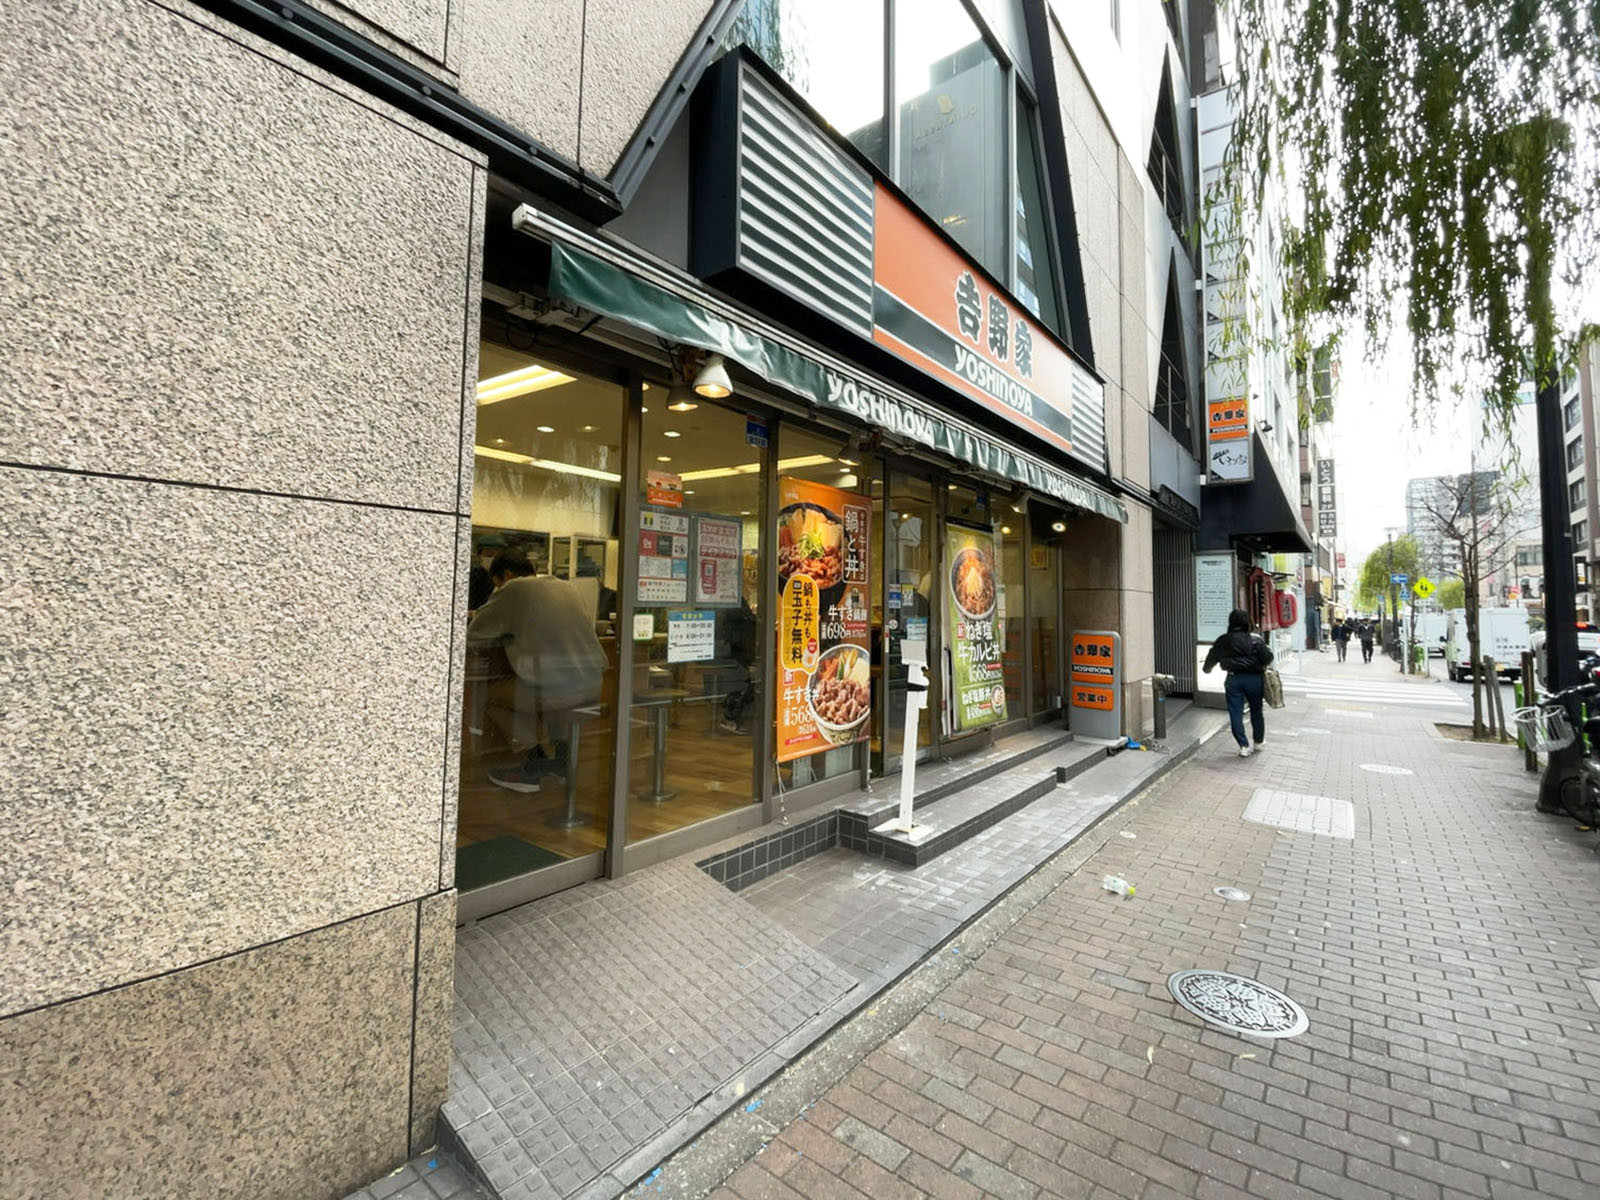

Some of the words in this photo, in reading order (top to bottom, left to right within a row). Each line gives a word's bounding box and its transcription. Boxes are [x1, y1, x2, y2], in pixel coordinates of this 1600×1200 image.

[955, 269, 1033, 380] 吉野家
[828, 373, 934, 443] YOSHINOYA
[955, 345, 1033, 417] YOSHINOYA
[845, 510, 859, 579] 鍋と丼
[792, 591, 803, 663] 玉子無料
[803, 582, 813, 638] 鍋も丼も
[966, 621, 993, 640] ねぎ塩
[958, 641, 1000, 665] 牛カルビ丼
[1074, 643, 1111, 658] 吉野家
[1077, 692, 1107, 704] 営業中
